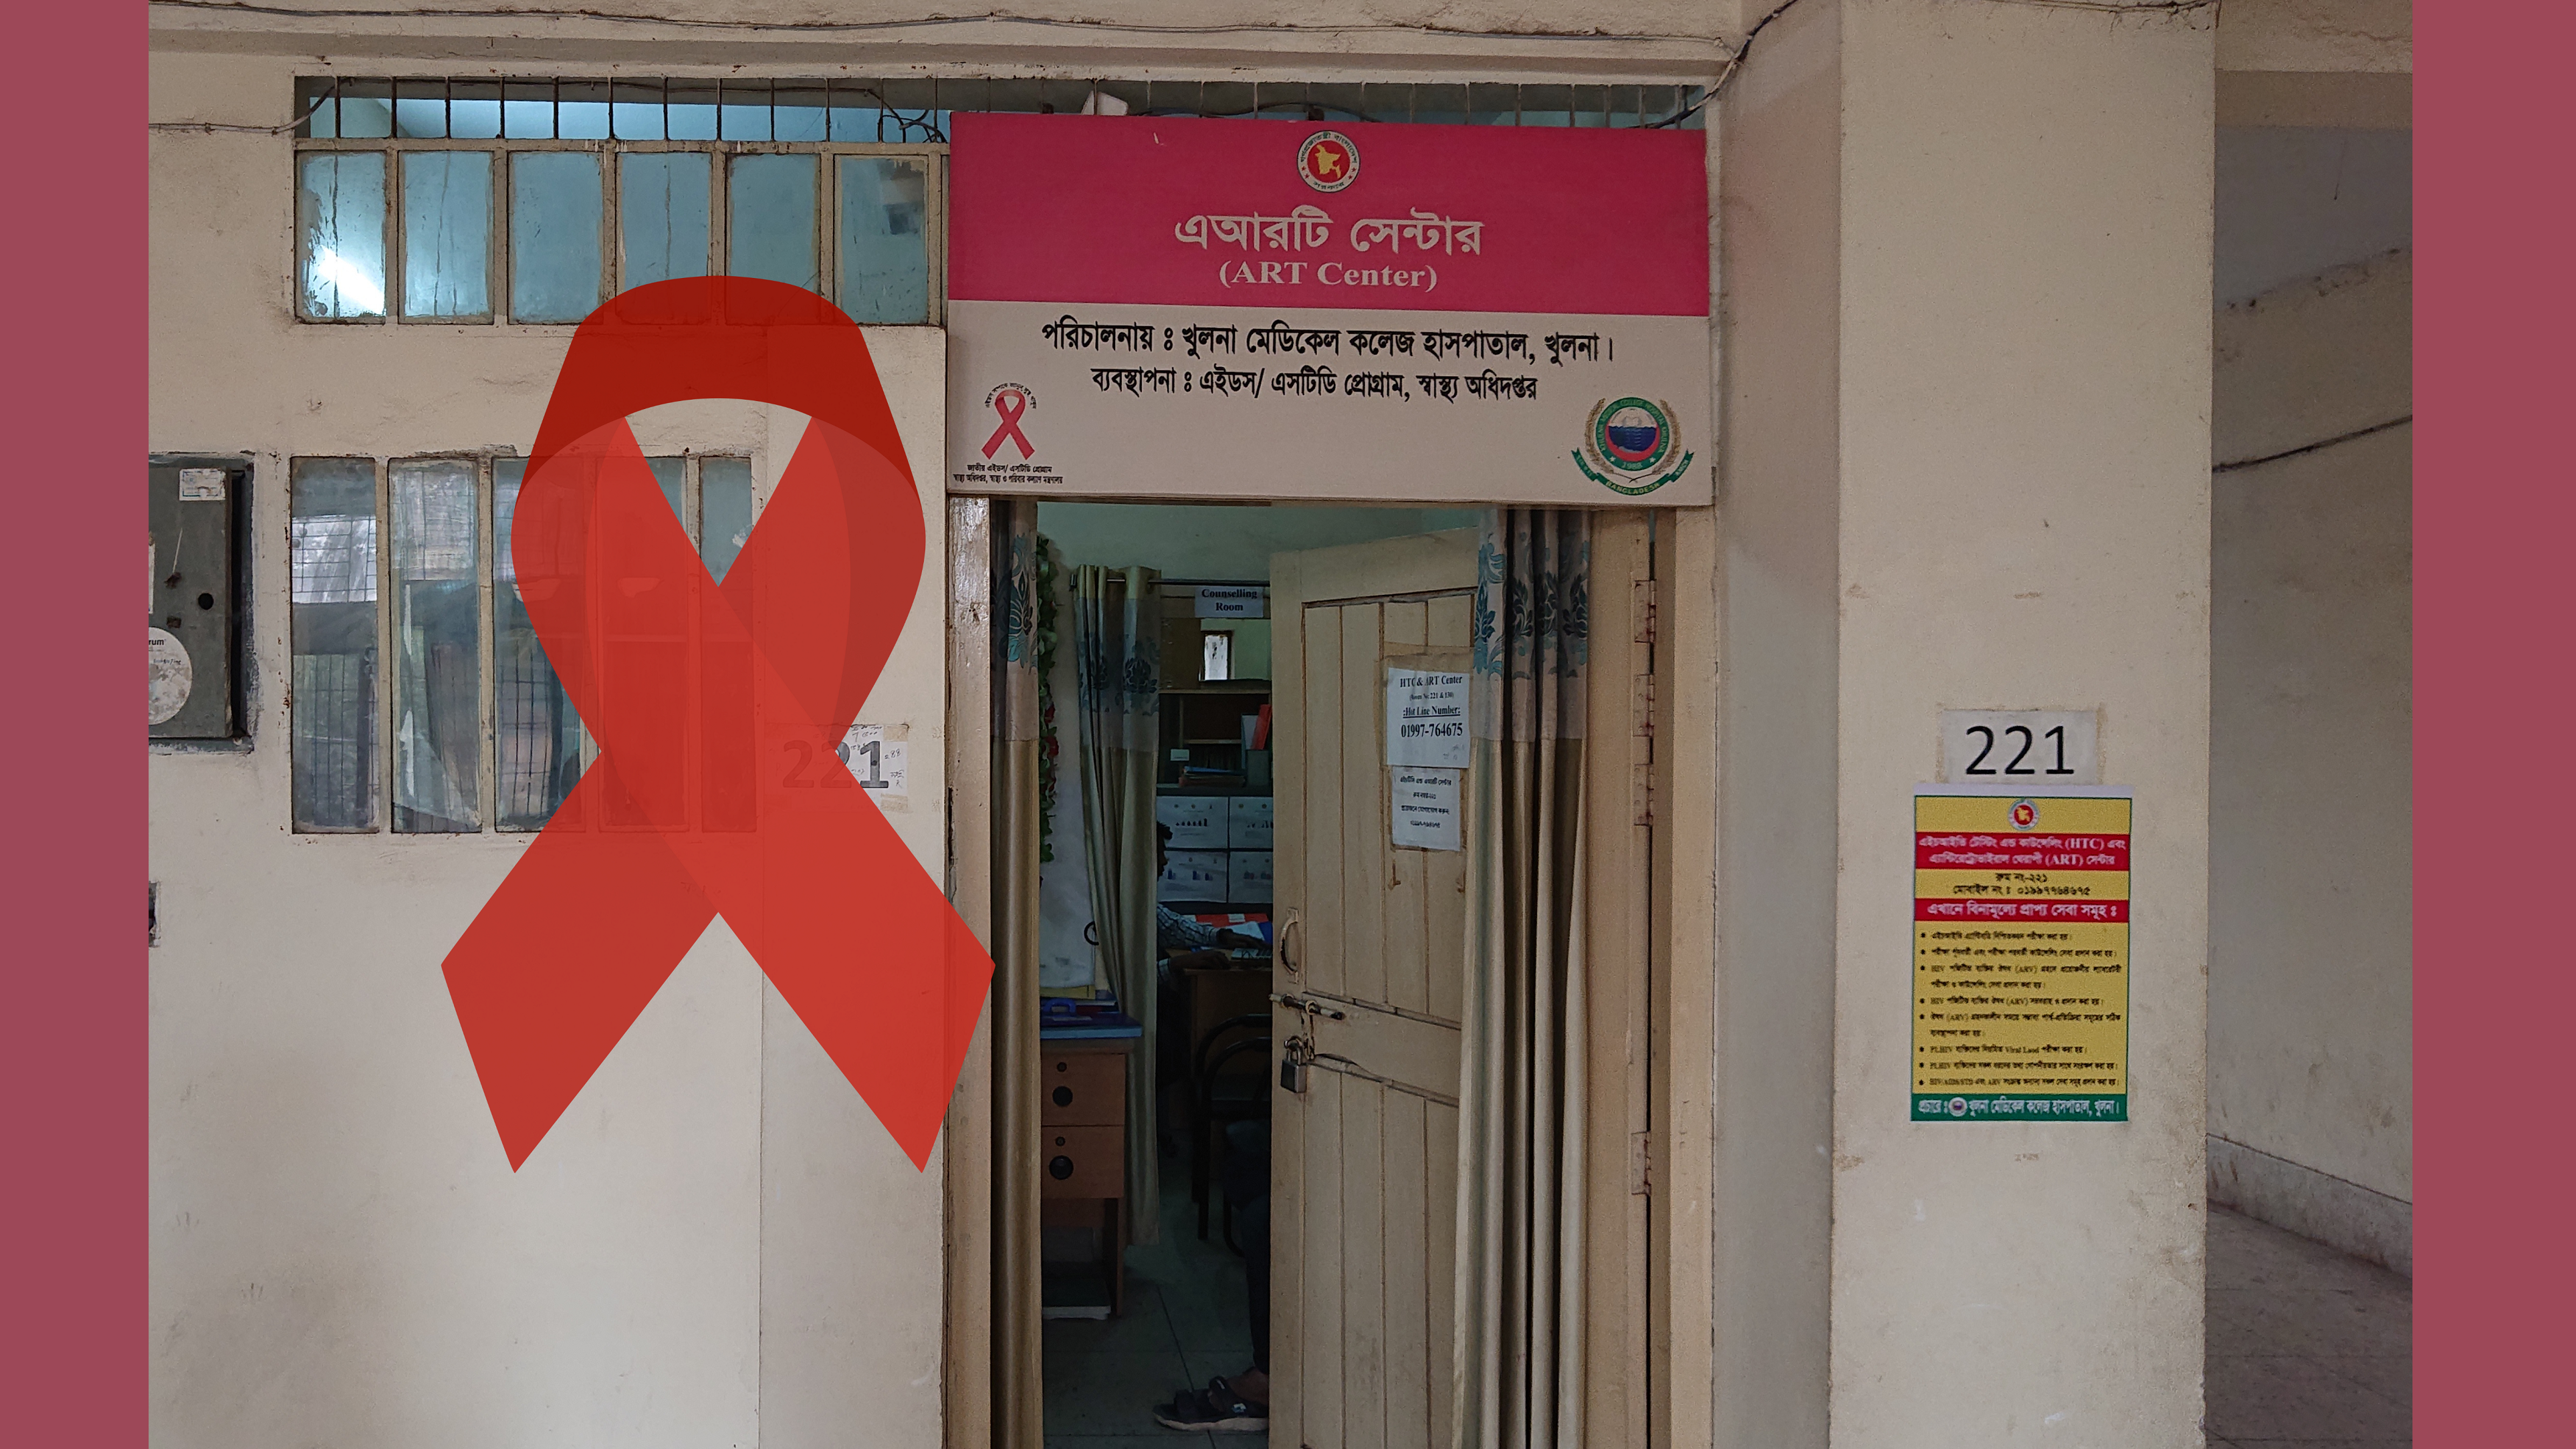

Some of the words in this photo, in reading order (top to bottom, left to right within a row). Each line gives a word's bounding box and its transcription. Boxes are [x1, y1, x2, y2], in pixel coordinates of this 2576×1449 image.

[1175, 205, 1334, 252] এআরটি
[1350, 207, 1486, 256] সেন্টার
[1219, 261, 1308, 288] (ART
[1316, 261, 1437, 293] Center)
[1042, 314, 1155, 352] পরিচালনায়
[1182, 323, 1238, 360] খুলনা
[1246, 320, 1342, 356] মেডিকেল
[1346, 330, 1416, 357] কলেজ
[1420, 329, 1536, 366] হাসপাতাল,
[1090, 366, 1177, 398] ব্যবস্থাপনা
[1199, 364, 1265, 398] এইডস/
[1272, 365, 1337, 396] এসটিডি
[1344, 371, 1410, 403] প্রোগ্রাম,
[1416, 372, 1459, 404] স্বাস্থ্য
[1464, 368, 1538, 400] অধিদপ্তর
[1606, 481, 1660, 495] BANGLADESH
[1201, 588, 1258, 600] Counselling
[1215, 602, 1244, 611] Room
[1400, 677, 1416, 688] HTC
[1425, 676, 1439, 686] ART
[1441, 675, 1463, 684] Center
[1401, 722, 1463, 738] 01997-764675
[1965, 724, 2075, 776] 221
[2065, 837, 2105, 850] (HTC)
[2044, 853, 2084, 866] (ART)
[1954, 883, 1989, 896] মোবাইল
[1927, 903, 1964, 916] এখানে
[1966, 900, 2017, 919] বিনামূল্যে
[2019, 904, 2047, 916] প্রাপ্য
[2051, 904, 2077, 917] সেবা
[2081, 904, 2107, 920] সমূহ
[1969, 1100, 1989, 1117] খুলনা
[1991, 1095, 2024, 1114] মেডিকেল
[2026, 1100, 2051, 1114] কলেজ
